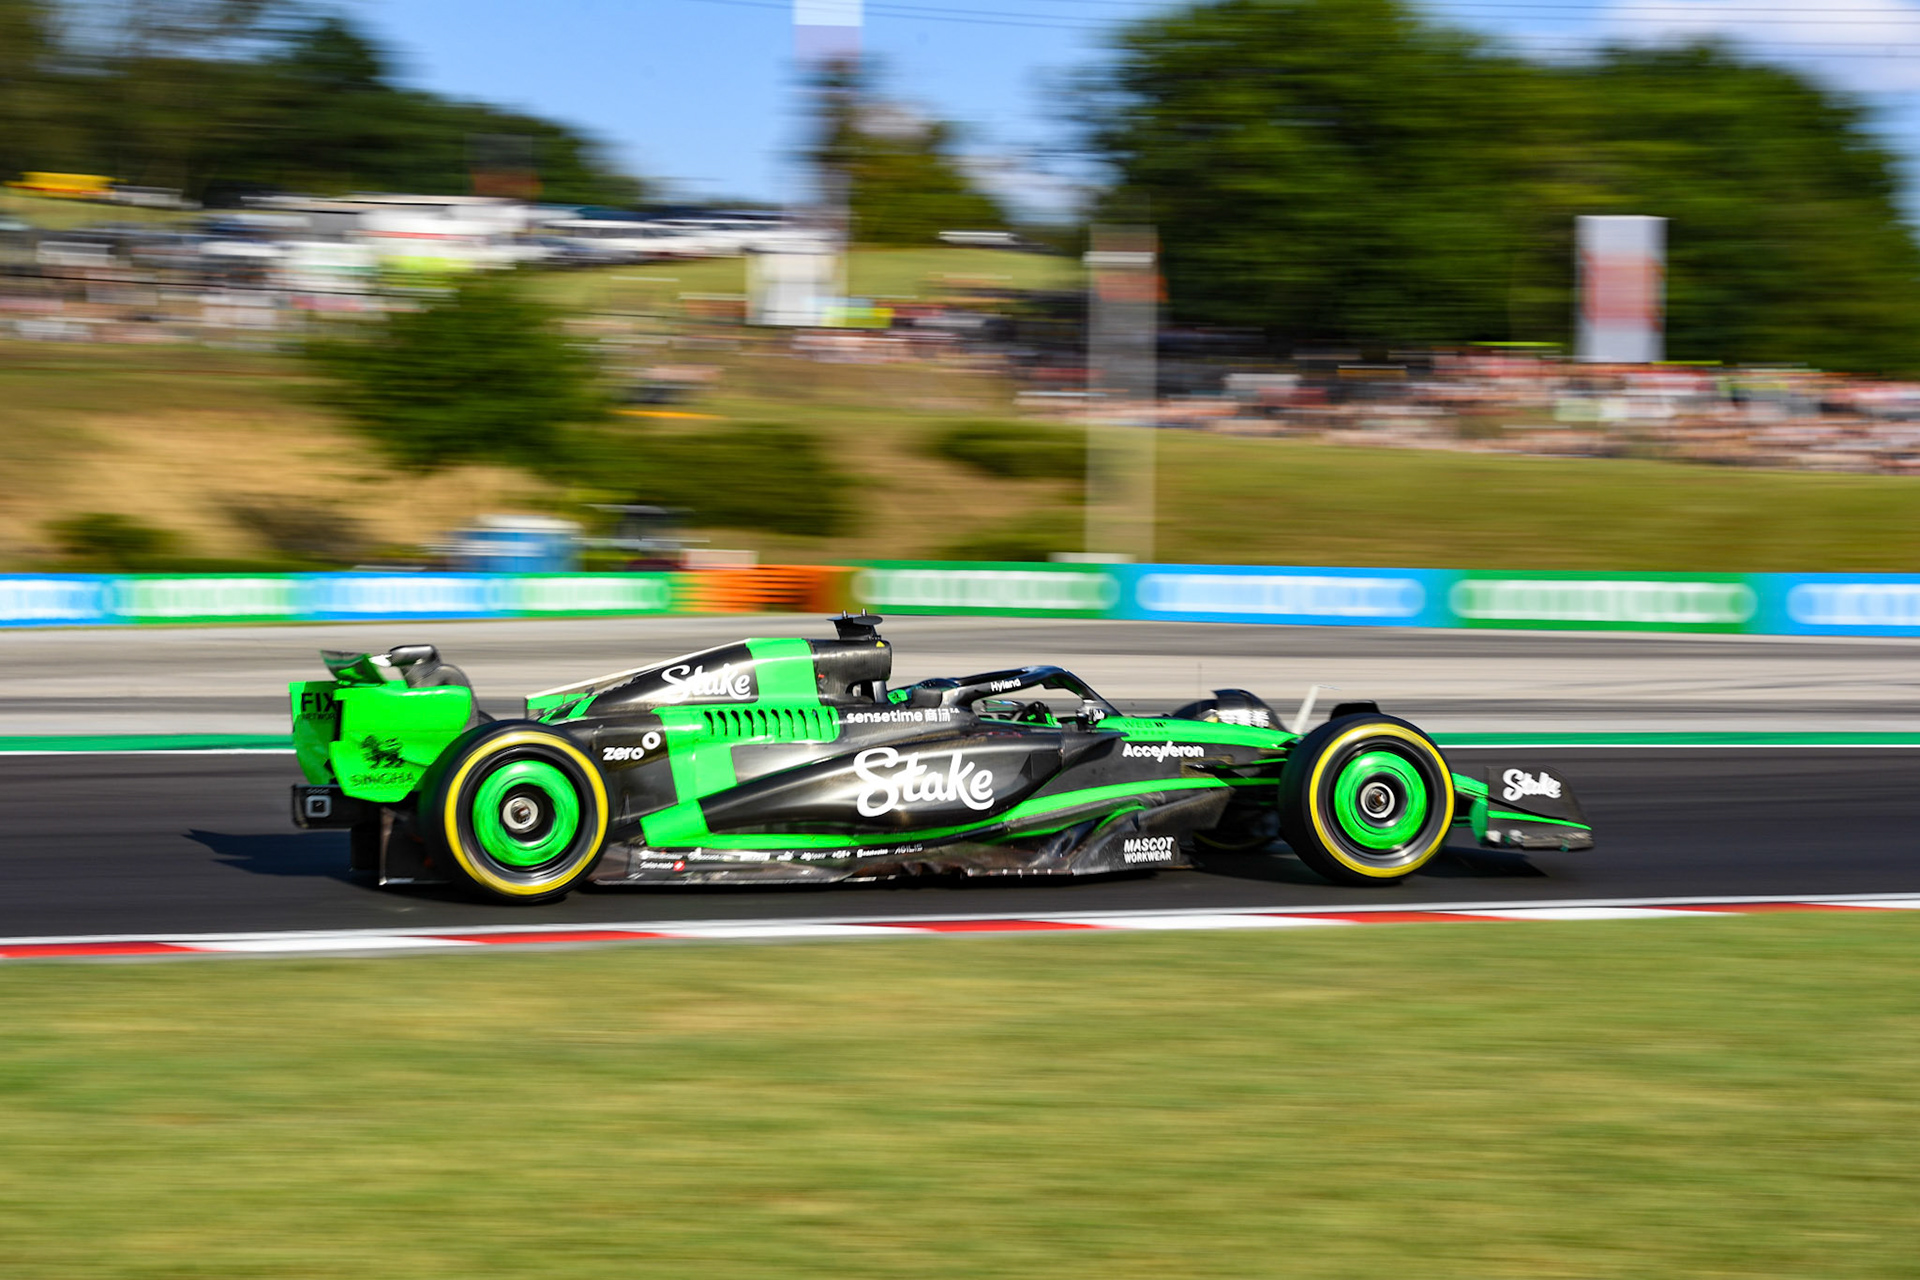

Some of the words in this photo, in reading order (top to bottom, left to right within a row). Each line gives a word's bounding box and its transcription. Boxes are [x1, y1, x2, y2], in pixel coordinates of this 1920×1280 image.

[661, 664, 751, 703] Stake
[990, 678, 1022, 692] Hyland
[301, 692, 338, 712] FIX
[846, 709, 923, 723] sensetime
[852, 747, 995, 818] Stake
[1502, 768, 1562, 801] Stake
[1123, 837, 1175, 853] MASCOT
[1123, 851, 1173, 864] WORKWEAR
